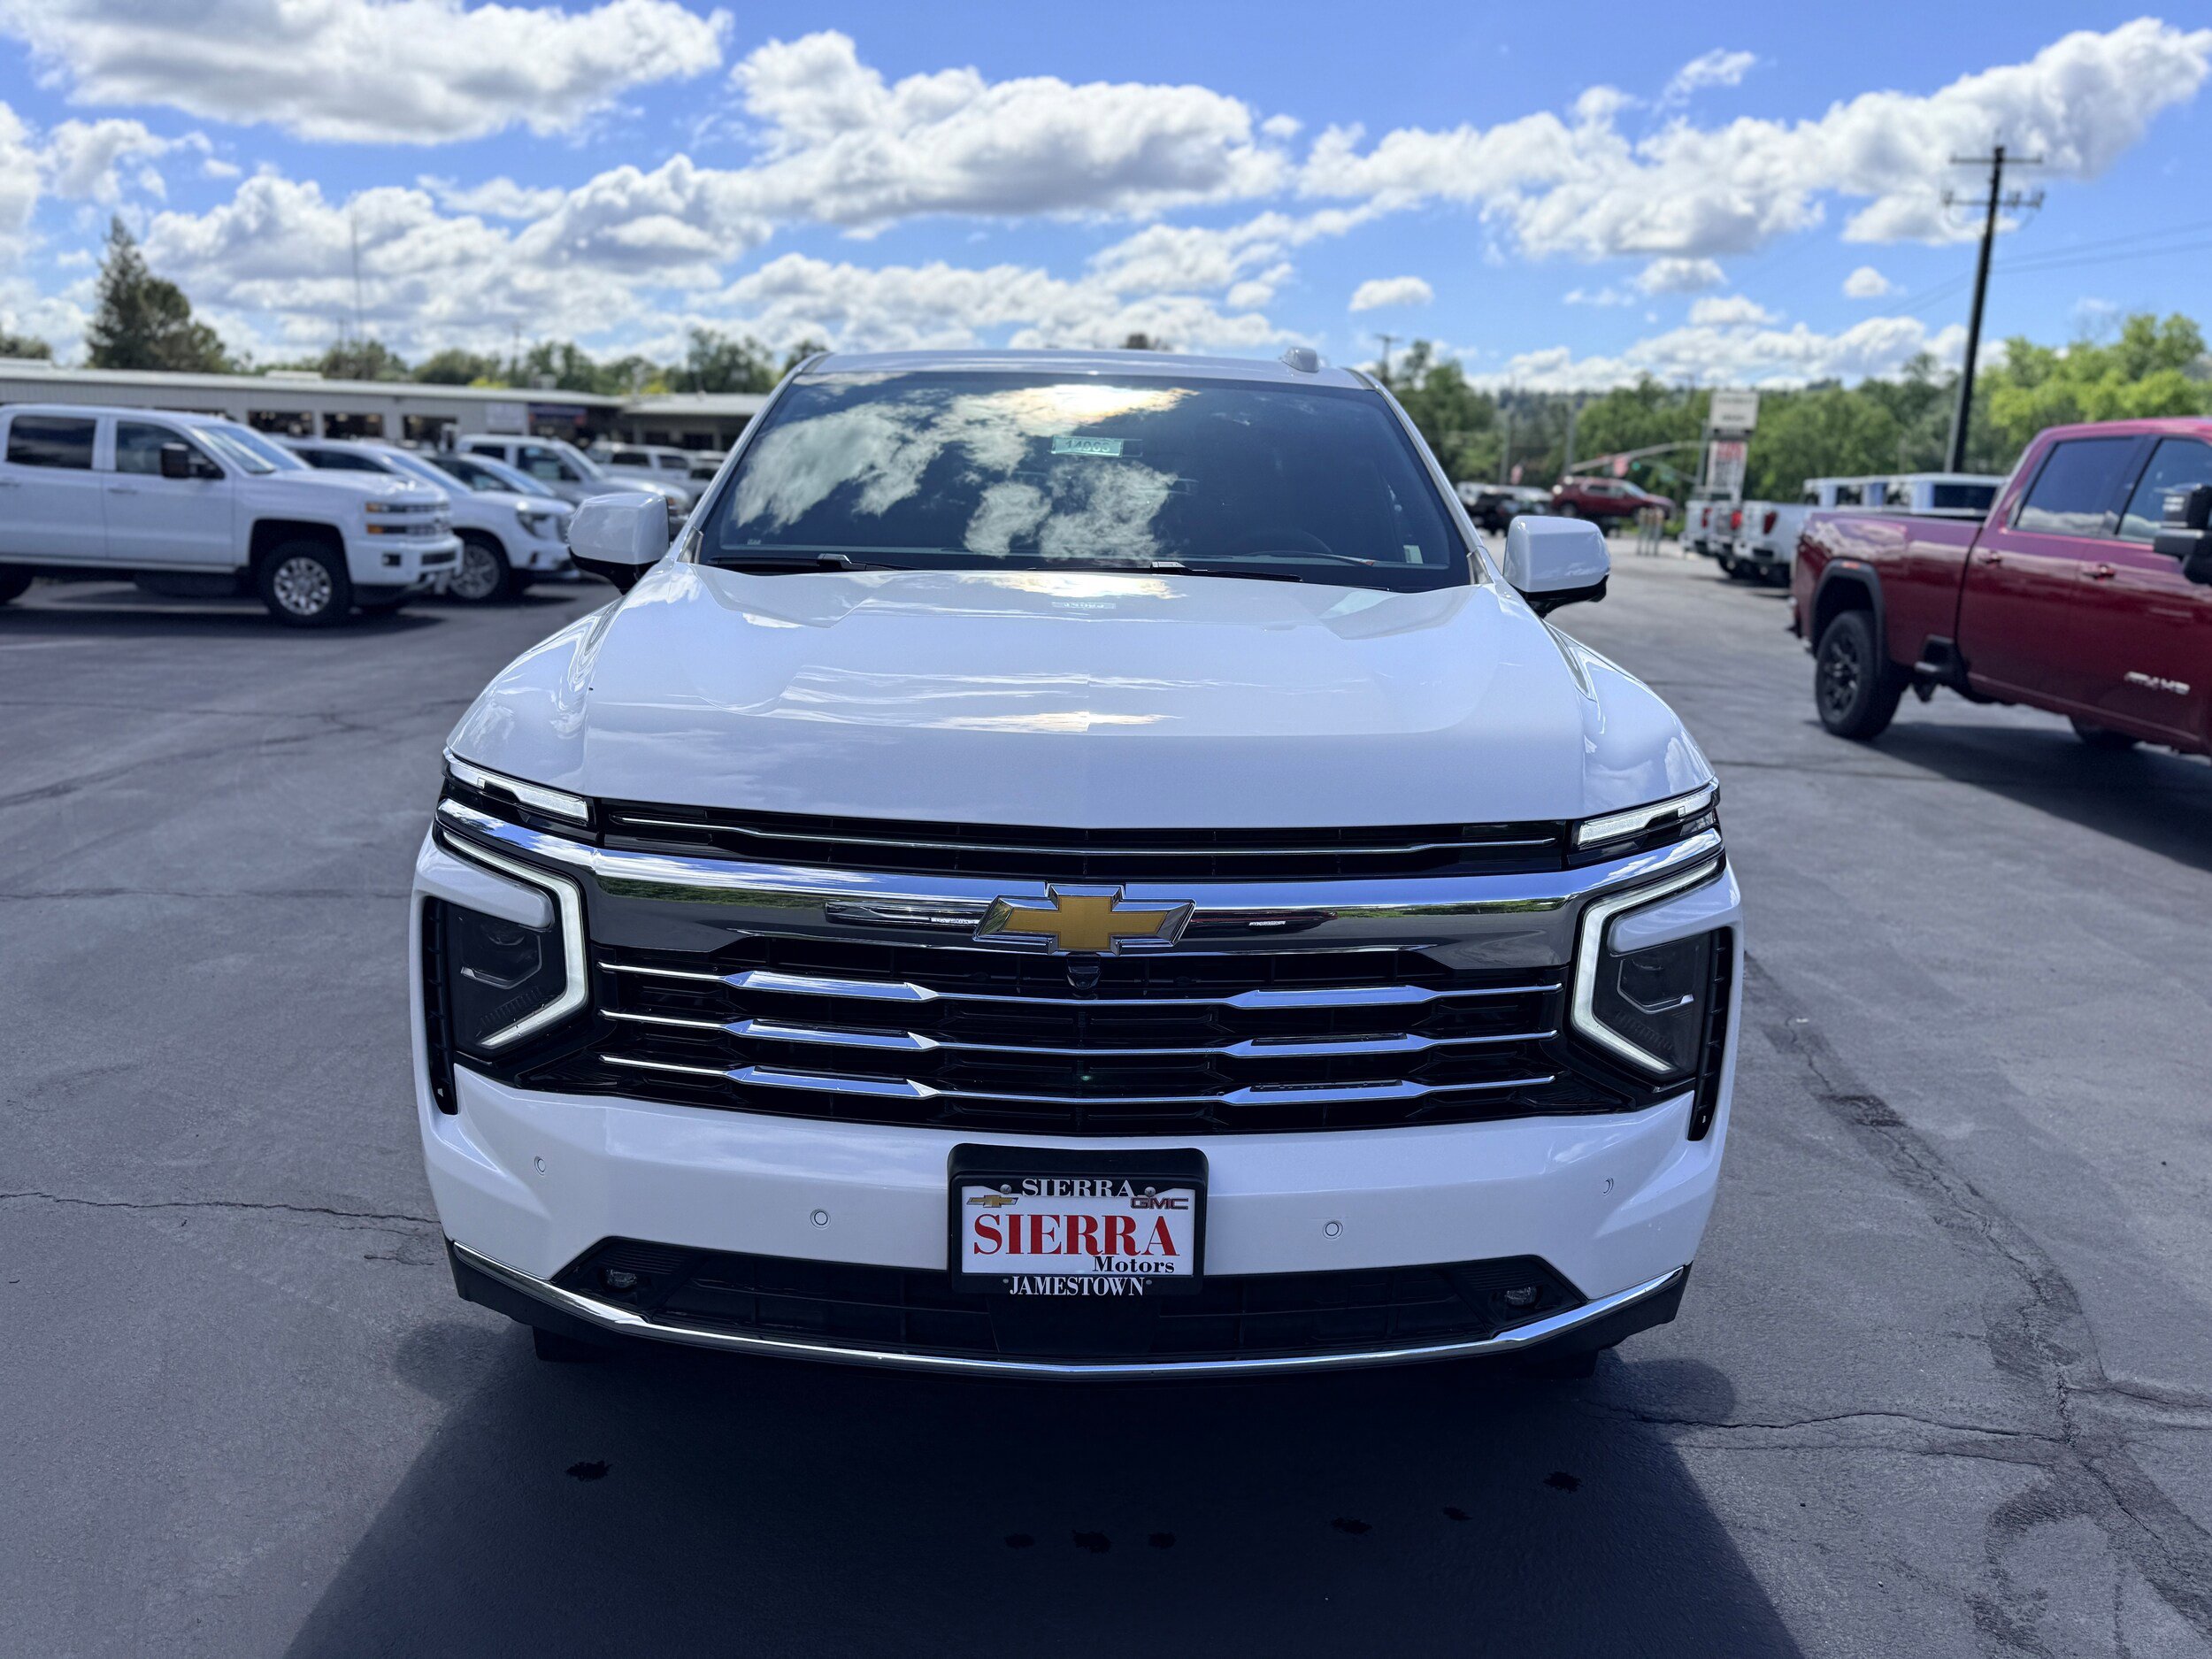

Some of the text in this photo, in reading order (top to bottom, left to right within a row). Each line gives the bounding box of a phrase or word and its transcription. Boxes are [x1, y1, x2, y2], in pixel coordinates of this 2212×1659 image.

[1022, 1179, 1136, 1197] SIERRA
[1130, 1197, 1188, 1210] GMC
[973, 1214, 1180, 1256] SIERRA
[1093, 1256, 1175, 1274] Motors
[1010, 1276, 1145, 1296] JAMESTOWN
